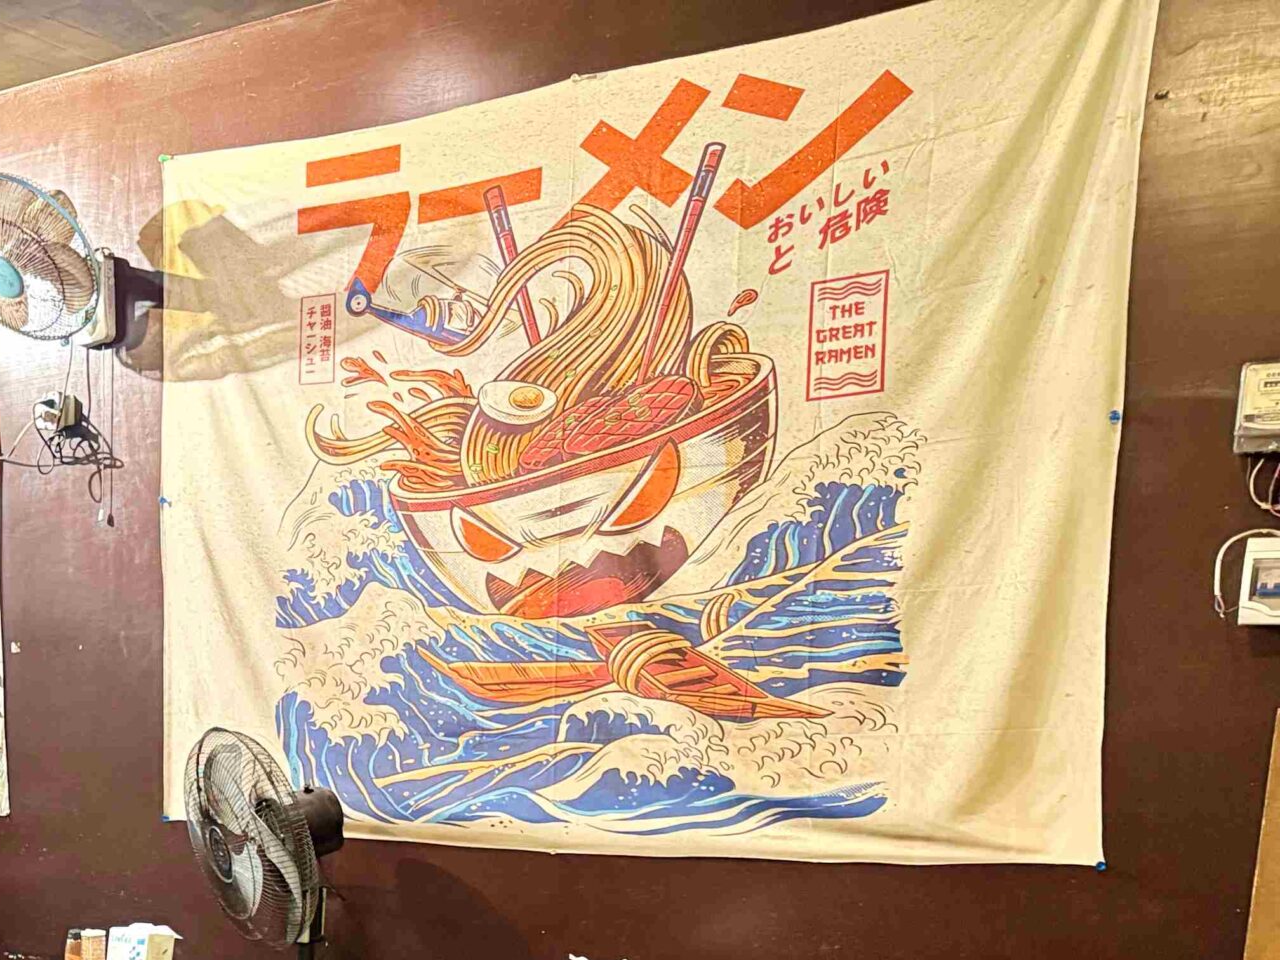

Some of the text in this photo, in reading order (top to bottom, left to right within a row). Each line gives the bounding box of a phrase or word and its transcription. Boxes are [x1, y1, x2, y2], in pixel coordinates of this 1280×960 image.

[297, 69, 914, 293] ラーメン
[767, 160, 890, 243] おいしい
[815, 321, 878, 344] GREAT
[829, 301, 865, 321] THE
[305, 306, 317, 374] チャーシュー
[814, 343, 876, 366] RAMEN
